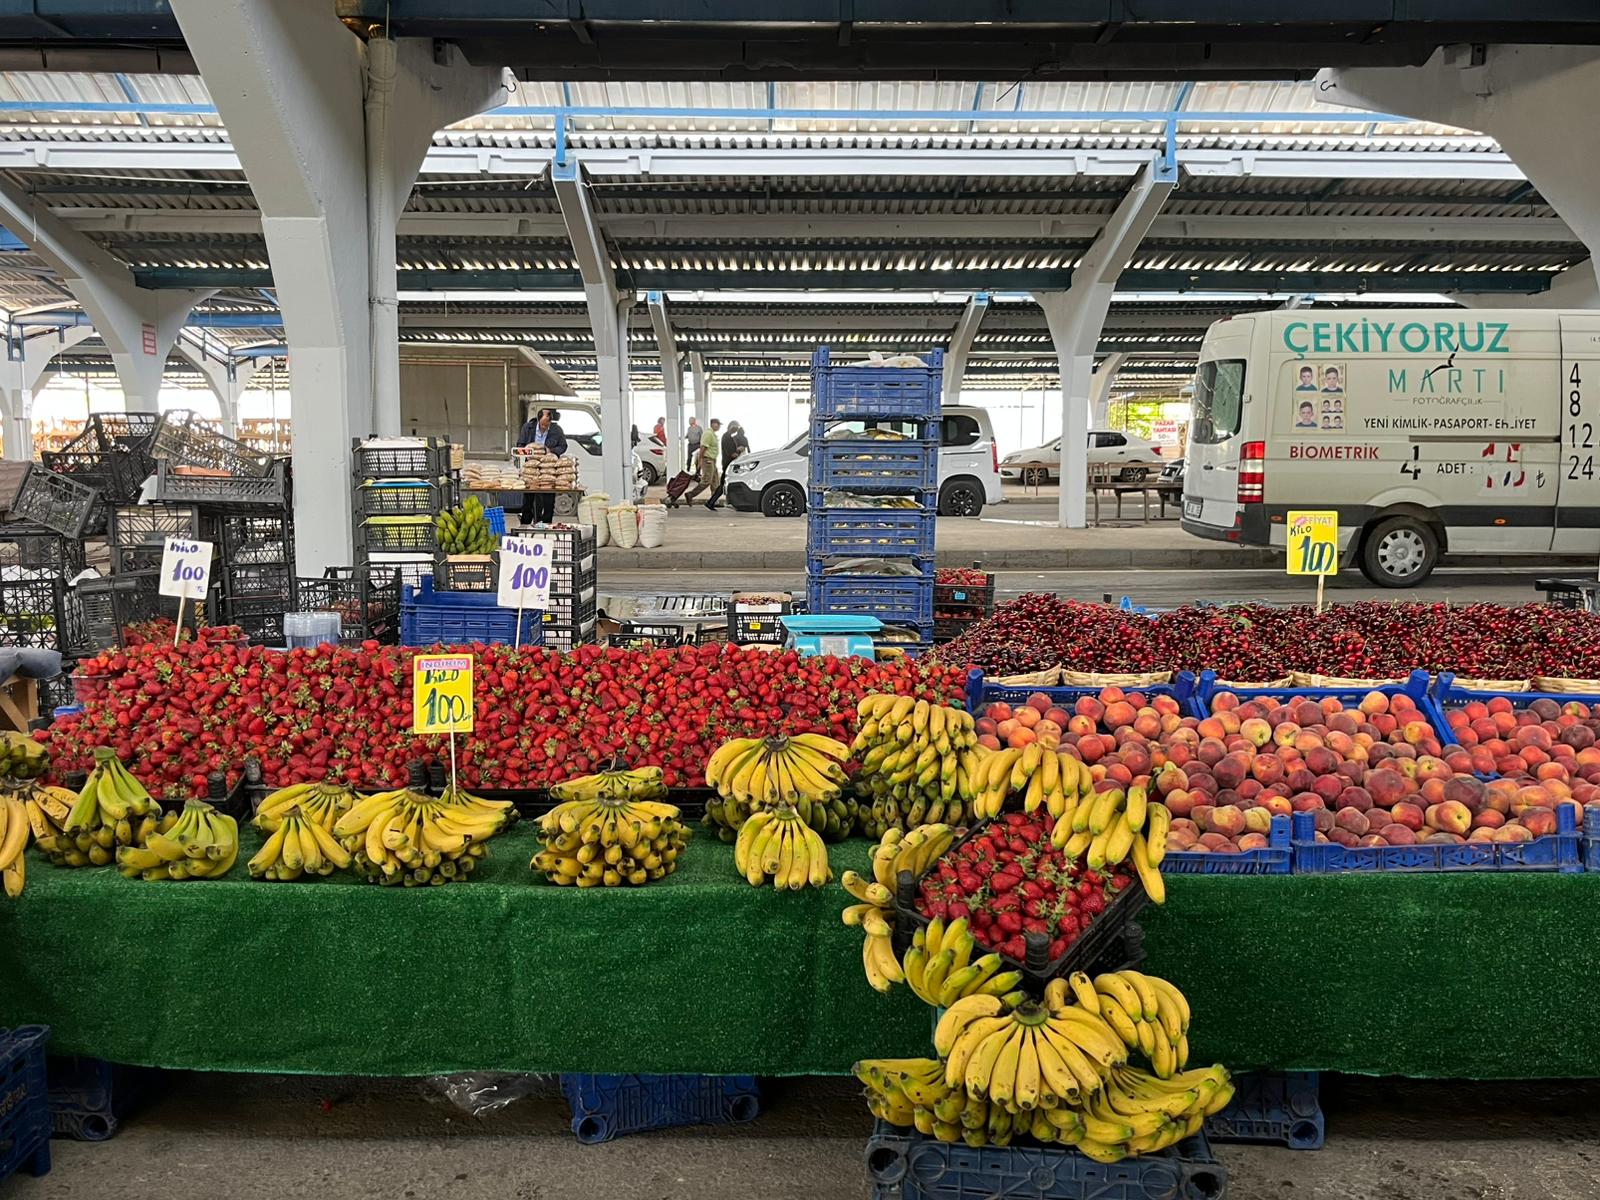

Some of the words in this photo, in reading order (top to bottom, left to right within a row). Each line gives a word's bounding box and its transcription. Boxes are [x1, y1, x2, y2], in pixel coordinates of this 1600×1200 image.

[1283, 317, 1509, 360] ÇEKİYORUZ
[1389, 368, 1504, 393] MARTI
[1569, 362, 1581, 388] 4
[1569, 390, 1581, 417] 8
[1363, 416, 1389, 429] YENİ
[1569, 422, 1593, 449] 12
[1290, 442, 1380, 459] BİOMETRİK
[1567, 455, 1594, 480] 24
[1296, 535, 1335, 572] 100
[172, 558, 204, 581] 100
[509, 562, 549, 590] 100
[421, 687, 465, 728] 100
